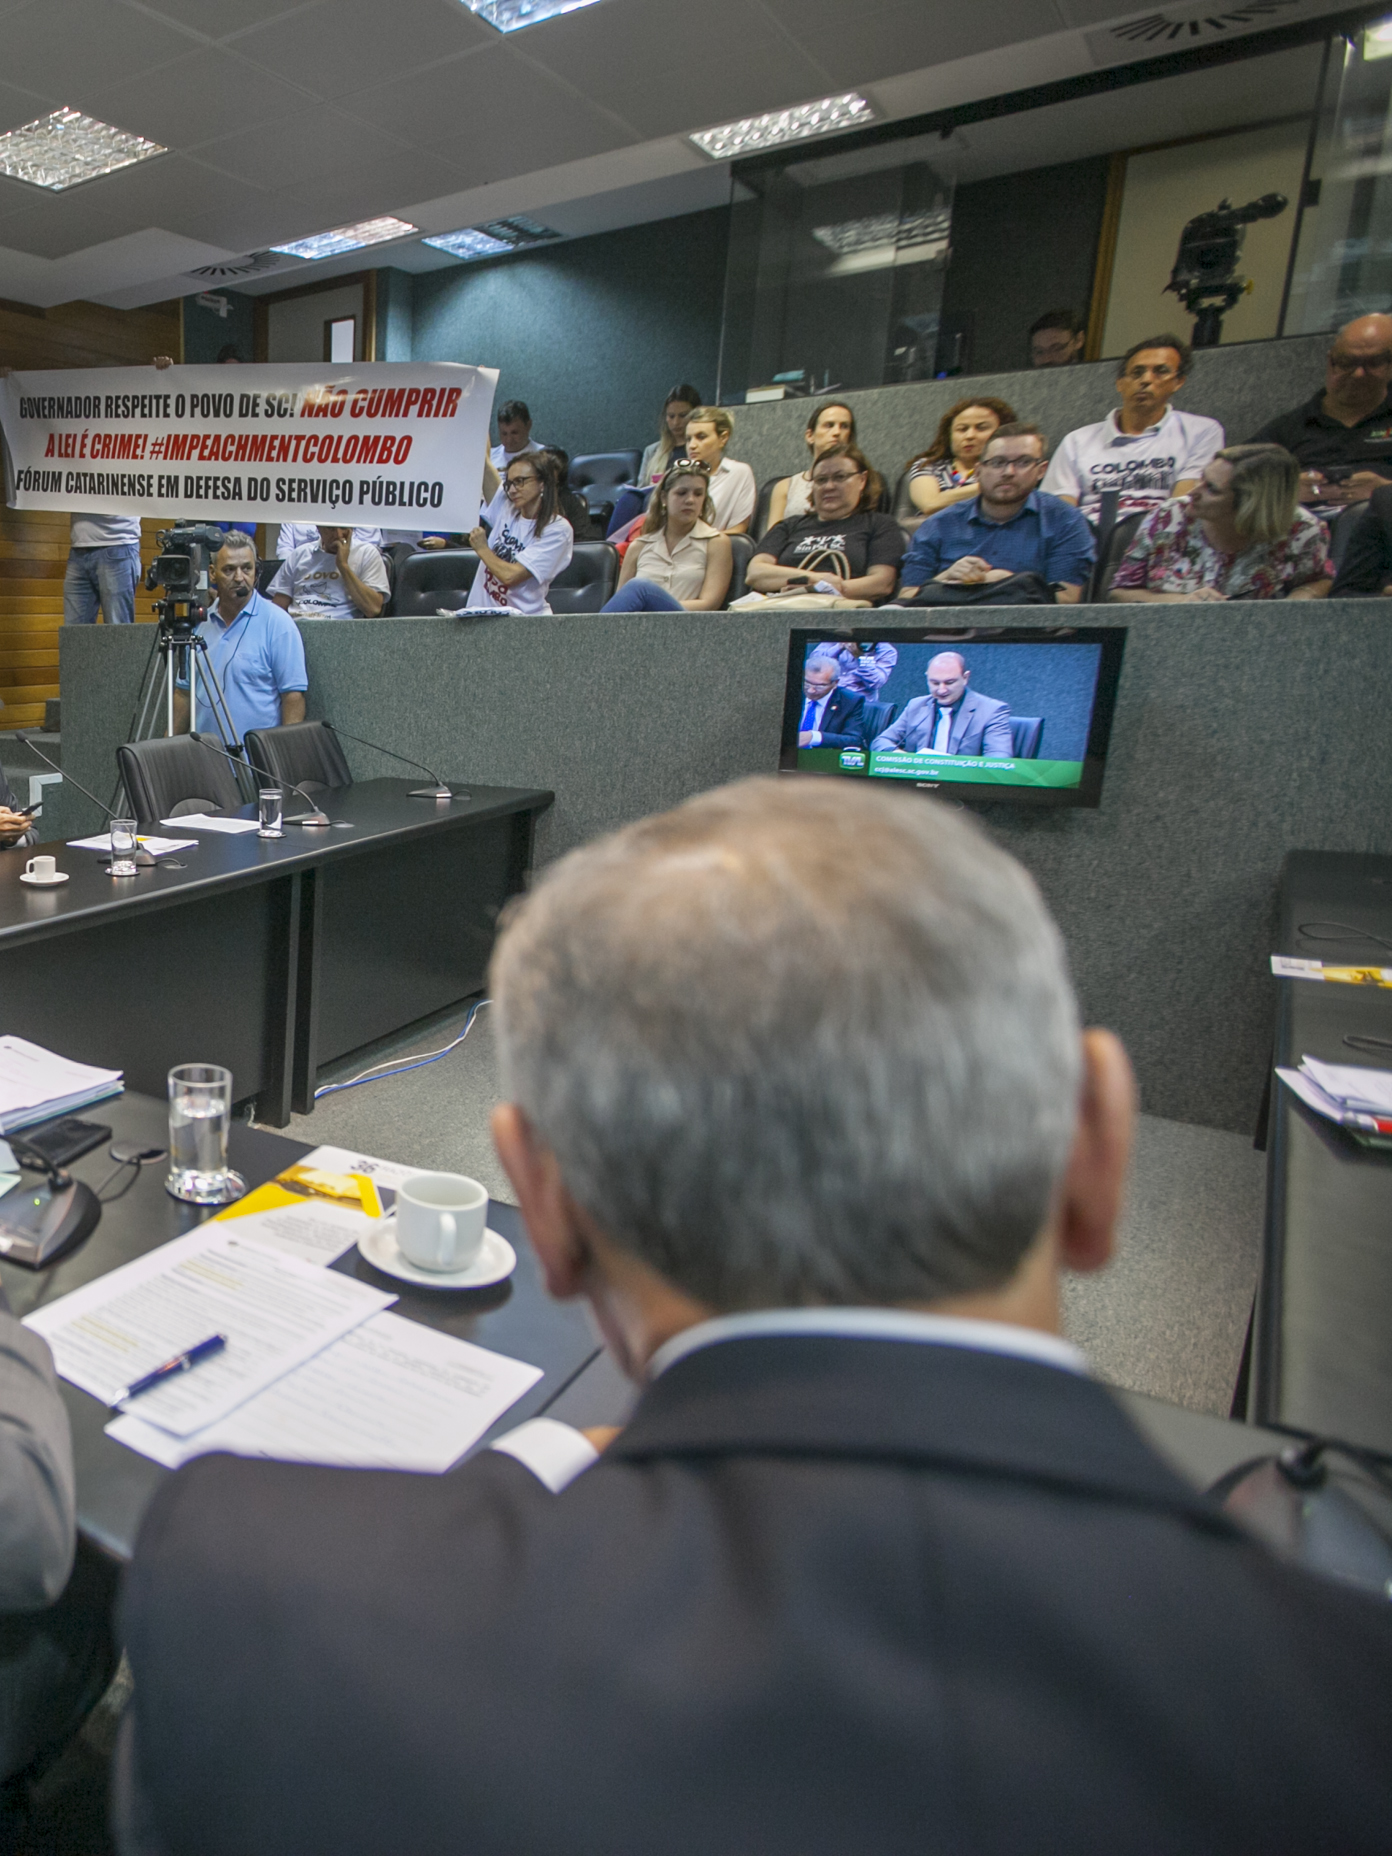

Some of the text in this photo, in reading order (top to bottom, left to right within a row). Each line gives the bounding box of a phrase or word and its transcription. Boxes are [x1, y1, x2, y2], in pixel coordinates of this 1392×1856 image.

[19, 385, 462, 419] GOVERNADOR RESPEITE O POVO DE SC! NÃO CUMPRIR
[44, 428, 413, 465] A LEI É CRIME! #IMPEACHMENTCOLOMBO
[16, 466, 444, 509] FÓRUM CATARINENSE EM DEFESA DO SERVIÇO PÚBLICO
